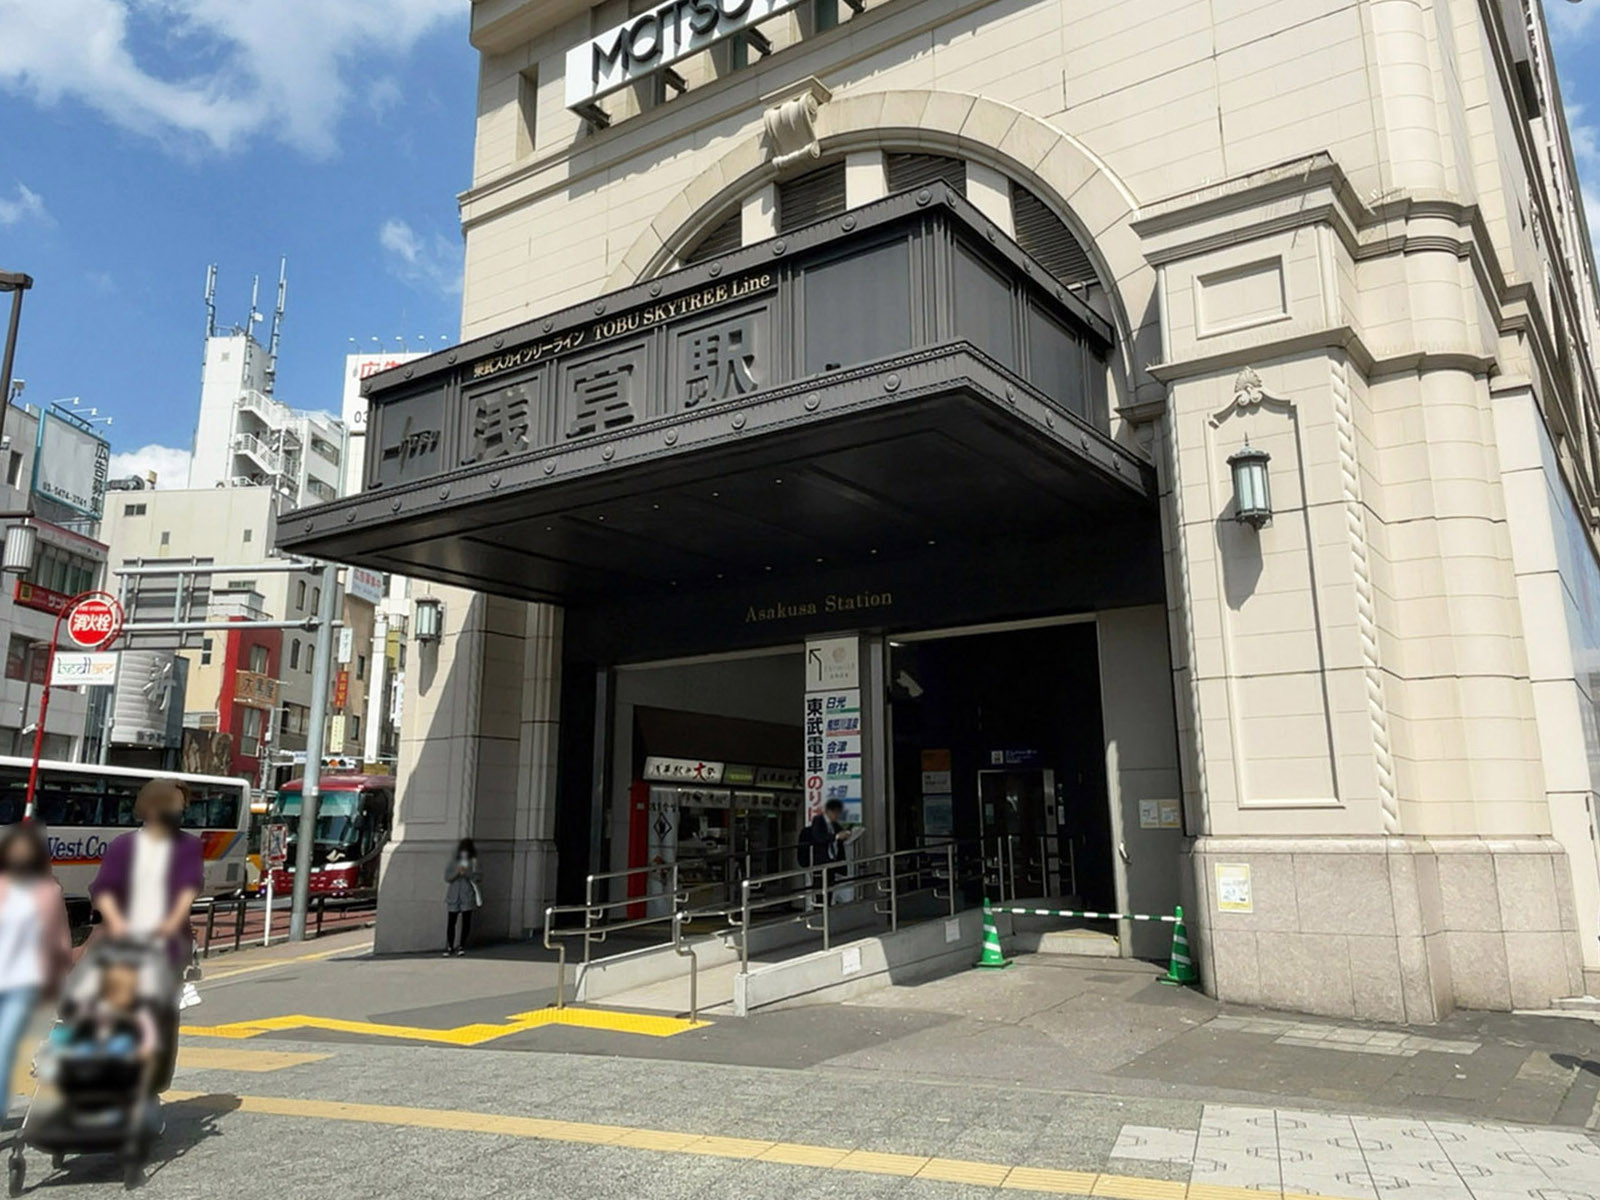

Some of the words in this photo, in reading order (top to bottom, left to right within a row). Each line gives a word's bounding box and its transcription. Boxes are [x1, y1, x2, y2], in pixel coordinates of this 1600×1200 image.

[593, 312, 640, 342] TOBU
[643, 284, 728, 326] SKYTREE
[731, 273, 771, 297] Line
[745, 602, 817, 623] Asakusa
[824, 591, 893, 613] Station
[72, 613, 111, 632] 消火栓
[826, 696, 847, 709] 日光
